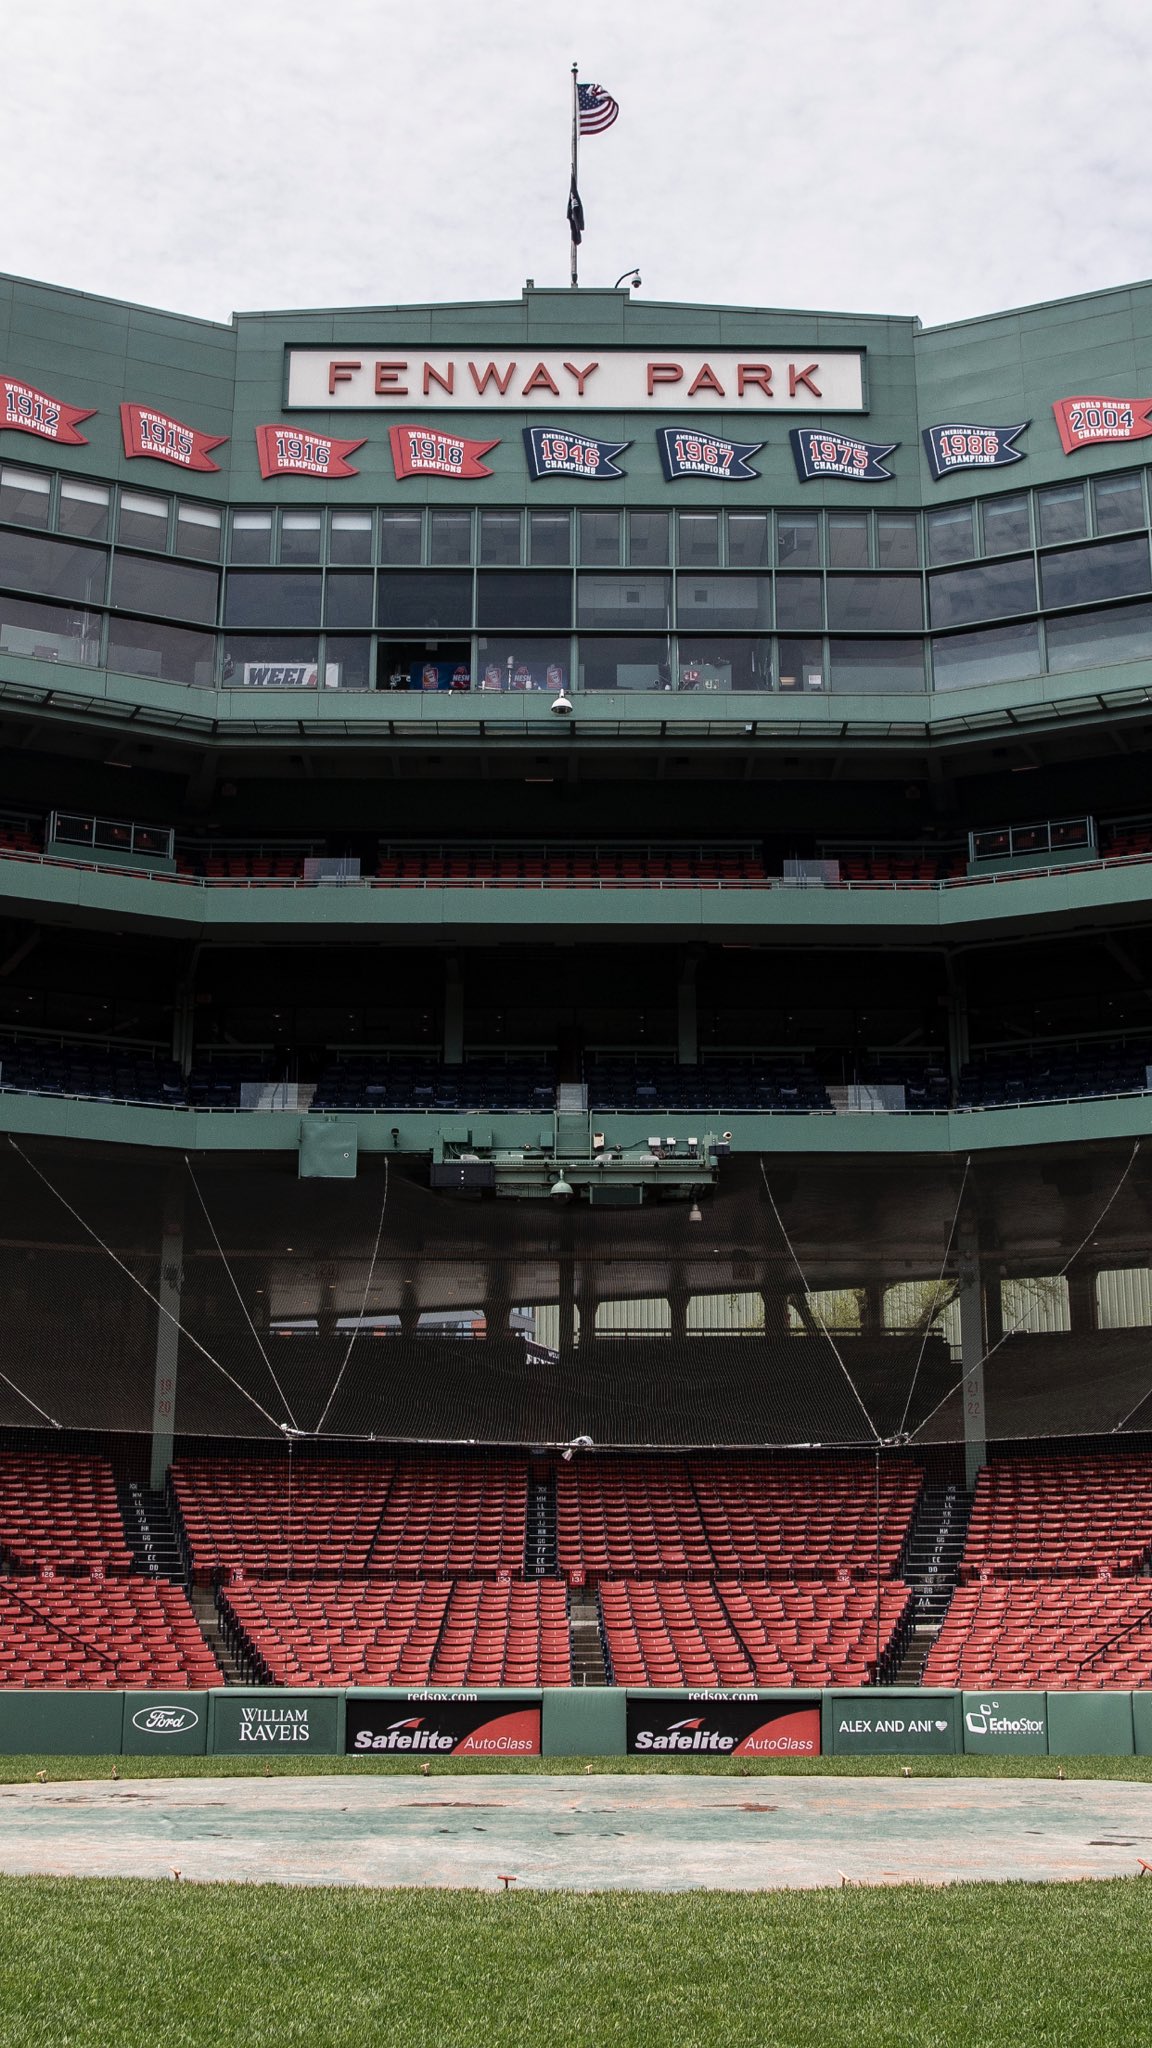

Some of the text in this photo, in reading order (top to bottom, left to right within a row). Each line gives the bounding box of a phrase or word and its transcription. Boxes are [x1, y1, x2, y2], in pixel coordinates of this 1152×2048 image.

[329, 361, 822, 398] FENWAY PARK
[4, 383, 61, 411] WORLD SERIES
[1072, 401, 1100, 410] WORLD
[6, 391, 60, 430] 1912
[6, 413, 57, 437] CHAMPIONS
[139, 411, 194, 438] WORLD SERIES
[1069, 408, 1134, 432] 2004
[140, 419, 193, 455] 1915
[275, 431, 331, 448] WORLD SERIES
[408, 431, 464, 448] WORLD SERIES
[542, 433, 598, 449] AMERICAN LEAGUE
[940, 429, 996, 437] AMERICAN LEAGUE
[1078, 428, 1130, 439] CHAMPIONS
[675, 434, 732, 450] AMERICAN LEAGUE
[810, 434, 866, 450] AMERICAN LEAGUE
[940, 434, 999, 458] 1986
[141, 440, 190, 464] CHAMPIONS
[276, 438, 330, 465] 1916
[410, 438, 463, 466] 1918
[541, 439, 600, 467] 1946
[674, 440, 734, 468] 1967
[809, 440, 868, 469] 1975
[945, 455, 995, 465] CHAMPIONS
[277, 458, 328, 473] CHAMPIONS
[411, 459, 462, 473] CHAMPIONS
[545, 460, 596, 474] CHAMPIONS
[680, 461, 730, 476] CHAMPIONS
[814, 461, 865, 476] CHAMPIONS
[249, 668, 306, 685] WEEI
[452, 674, 470, 682] NESN
[968, 1381, 979, 1393] 21
[968, 1403, 980, 1415] 22
[407, 1690, 477, 1701] redsox.com
[688, 1690, 758, 1701] redsox.com
[145, 1710, 185, 1728] Ford
[241, 1707, 308, 1722] WILLIAM
[239, 1722, 310, 1741] RAVEIS
[839, 1720, 932, 1733] ALEX AND ANI
[990, 1717, 1044, 1731] EchoStor
[354, 1730, 533, 1750] Safelite AutoGlass
[634, 1731, 814, 1750] Safelite AutoGlass
